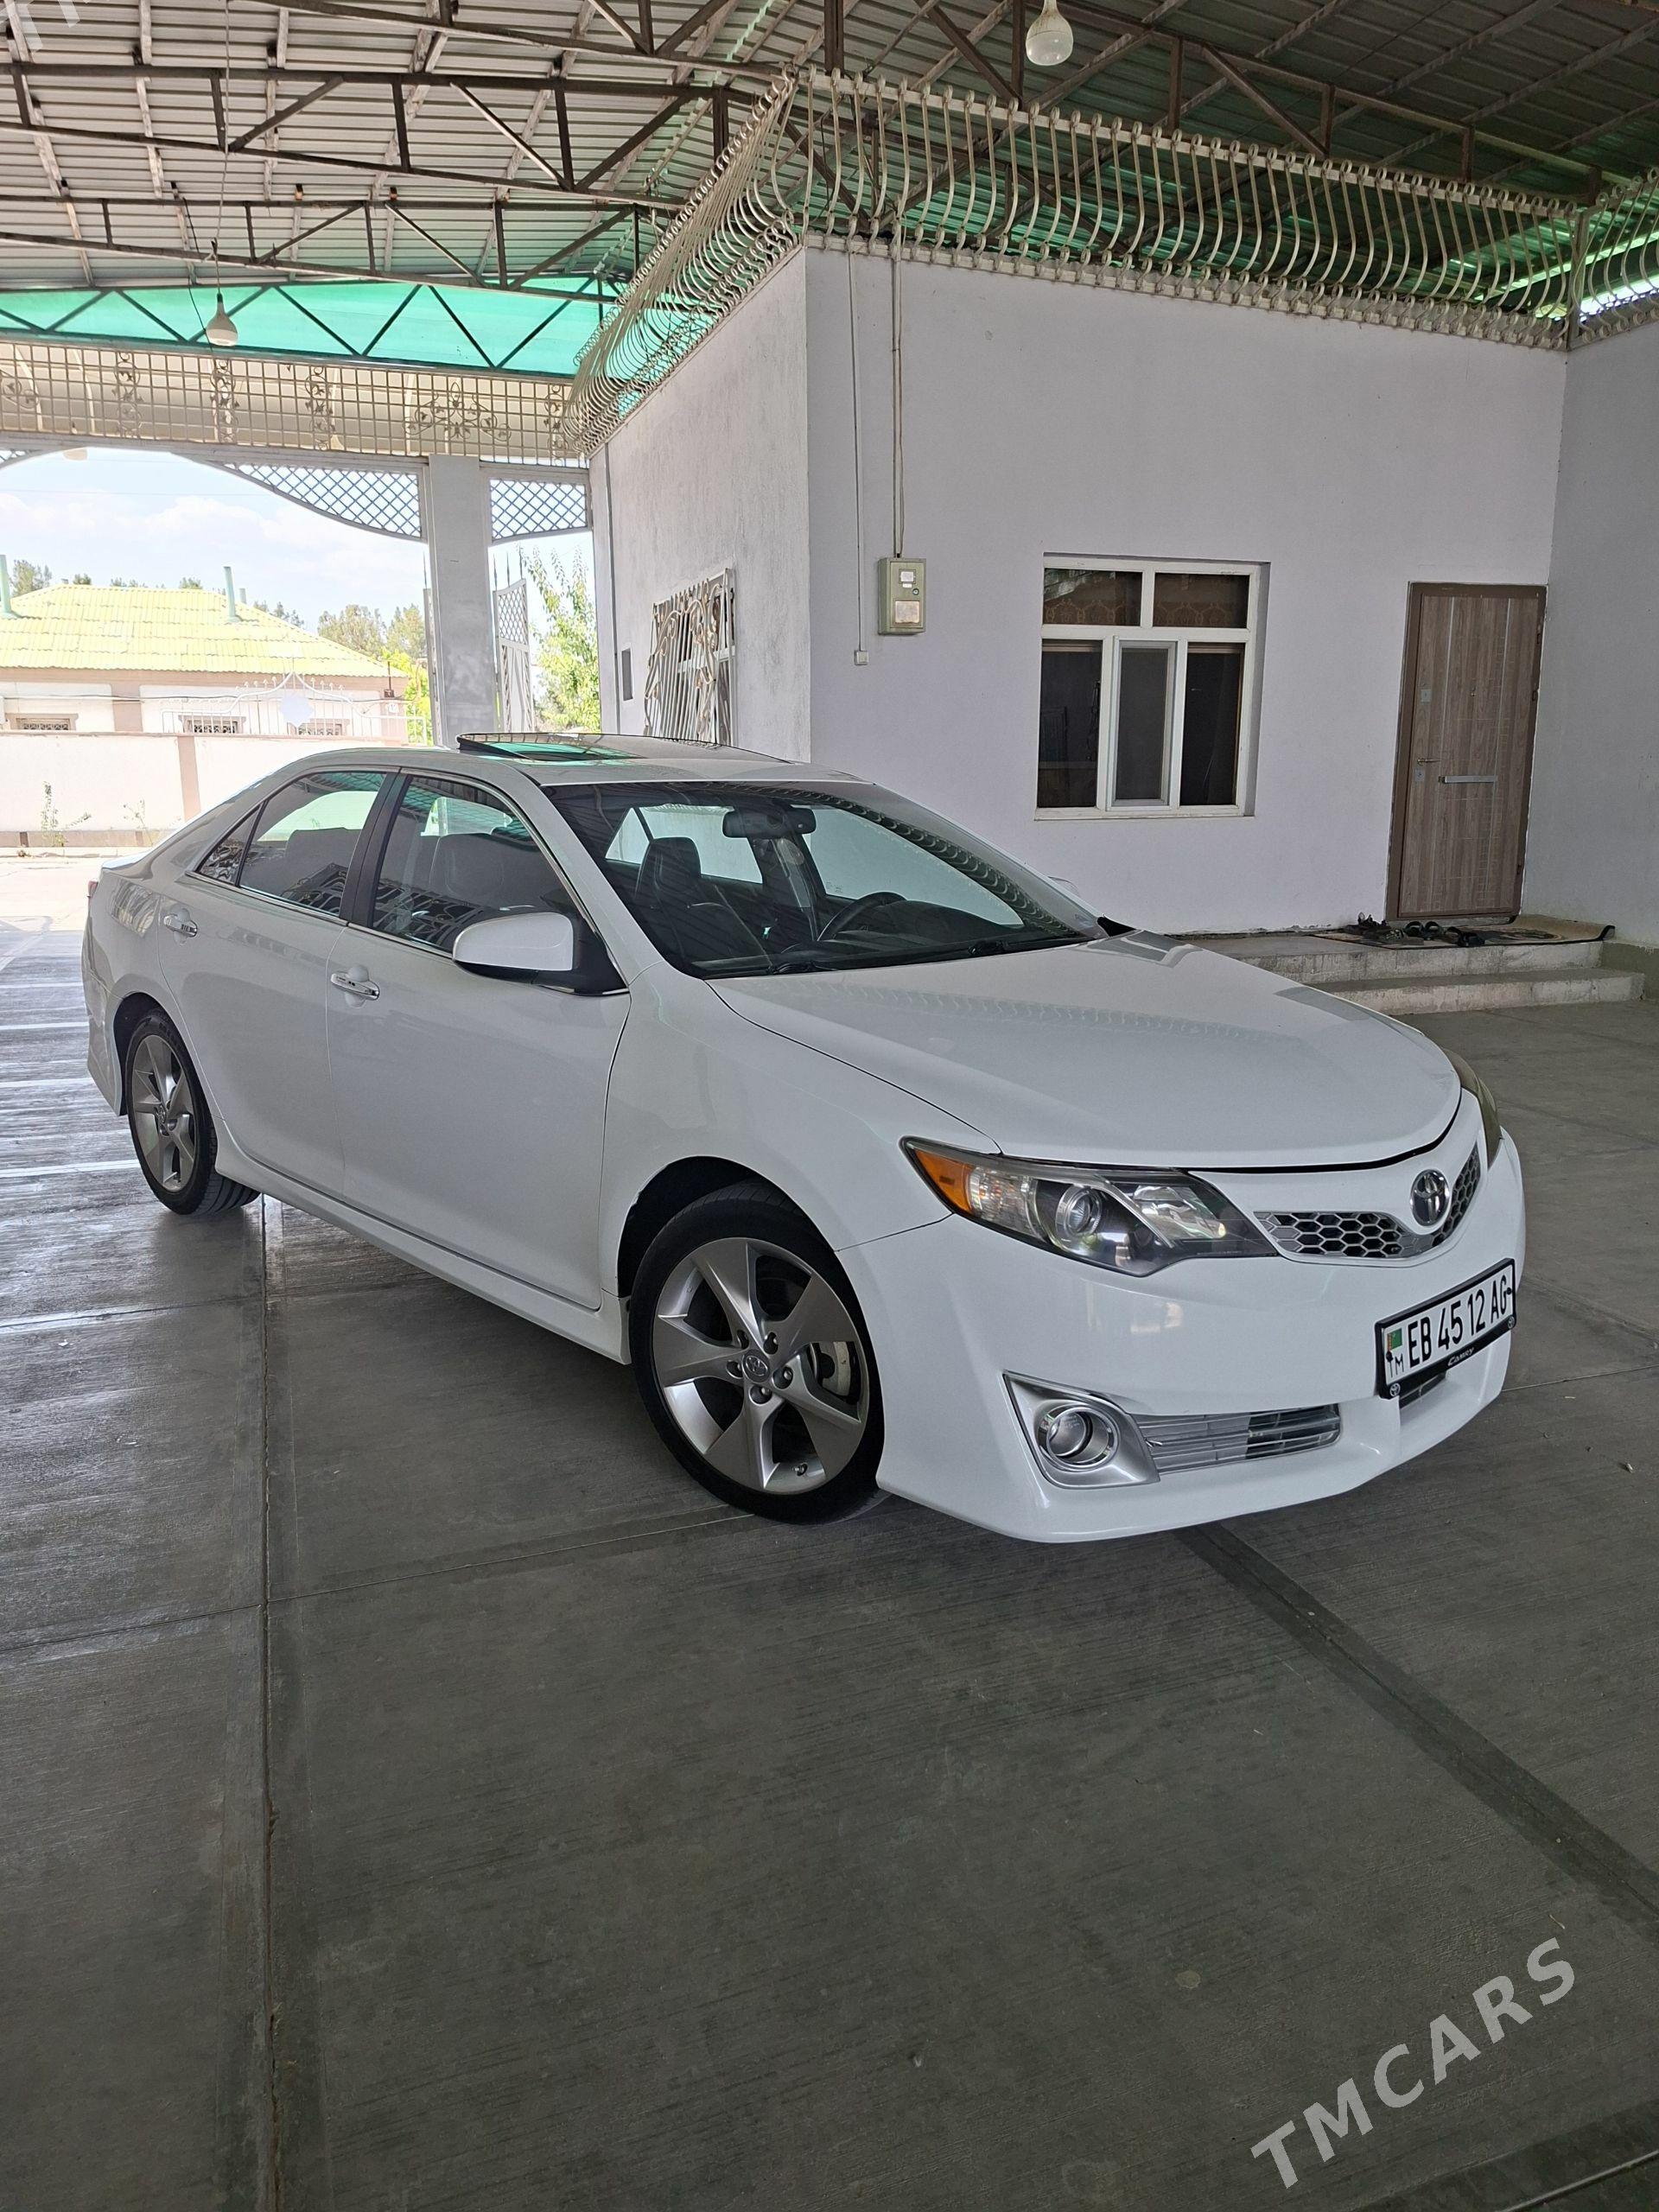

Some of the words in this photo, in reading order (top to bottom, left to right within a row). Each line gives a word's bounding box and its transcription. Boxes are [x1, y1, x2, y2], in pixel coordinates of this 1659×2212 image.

[1408, 1316, 1432, 1368] EB
[1438, 1300, 1464, 1350] 45
[1467, 1288, 1486, 1336] 12
[1491, 1274, 1507, 1324] AG
